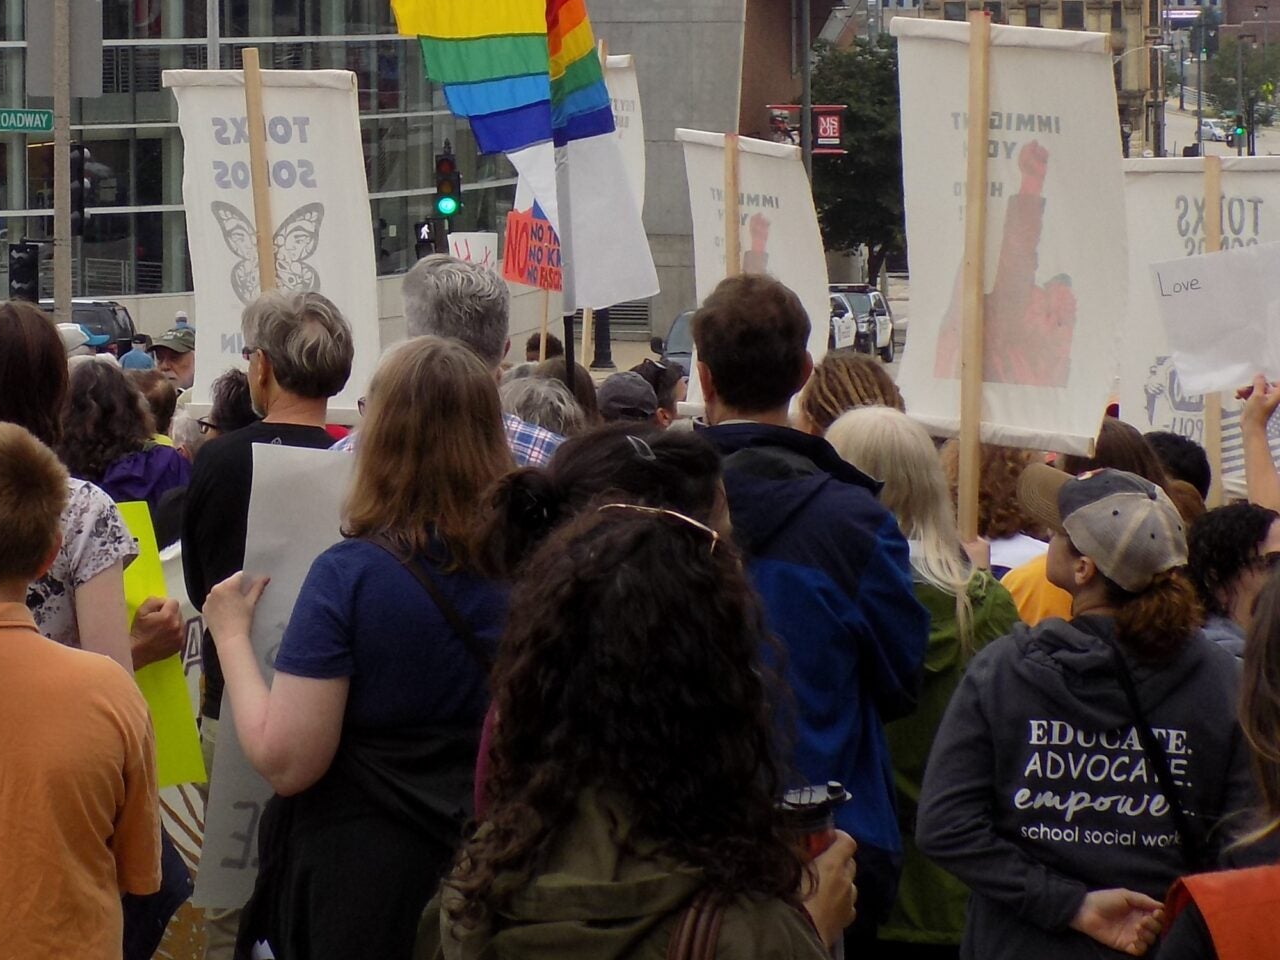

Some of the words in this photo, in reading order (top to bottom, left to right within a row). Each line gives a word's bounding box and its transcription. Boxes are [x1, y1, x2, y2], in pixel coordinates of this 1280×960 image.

[531, 223, 544, 243] NO
[505, 219, 529, 279] NO
[529, 246, 543, 265] NO
[1157, 271, 1201, 297] Love
[1024, 751, 1192, 787] ADVOCAE.
[1014, 788, 1195, 823] empowe.
[1021, 823, 1079, 842] school
[1084, 829, 1136, 844] social
